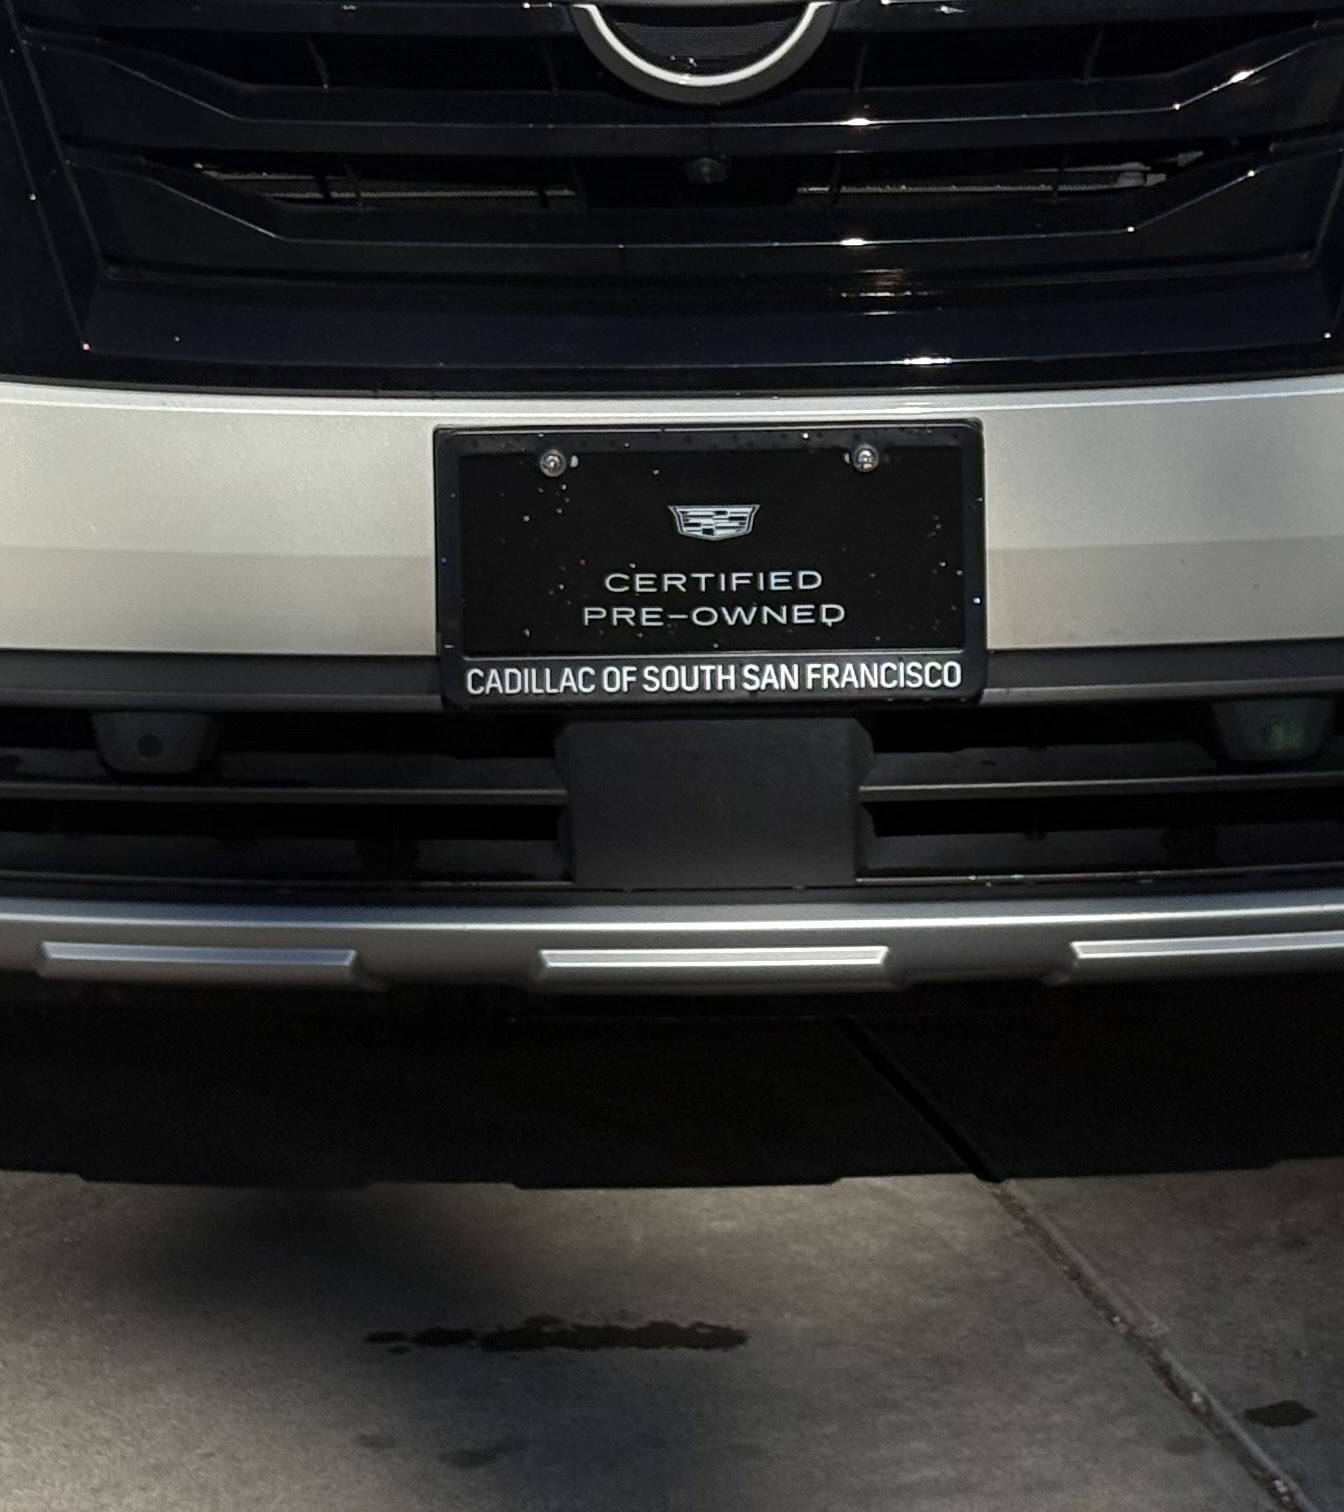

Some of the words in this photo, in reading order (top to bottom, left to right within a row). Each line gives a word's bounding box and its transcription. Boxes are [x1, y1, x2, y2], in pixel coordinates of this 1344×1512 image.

[604, 570, 823, 593] CERTIFIED
[583, 604, 847, 627] PRE-OWNED
[466, 667, 596, 695] CADILLAC
[604, 666, 637, 693] OF
[642, 664, 736, 692] SOUTH
[742, 664, 799, 690] SAN
[807, 661, 963, 689] FRANCISCO
